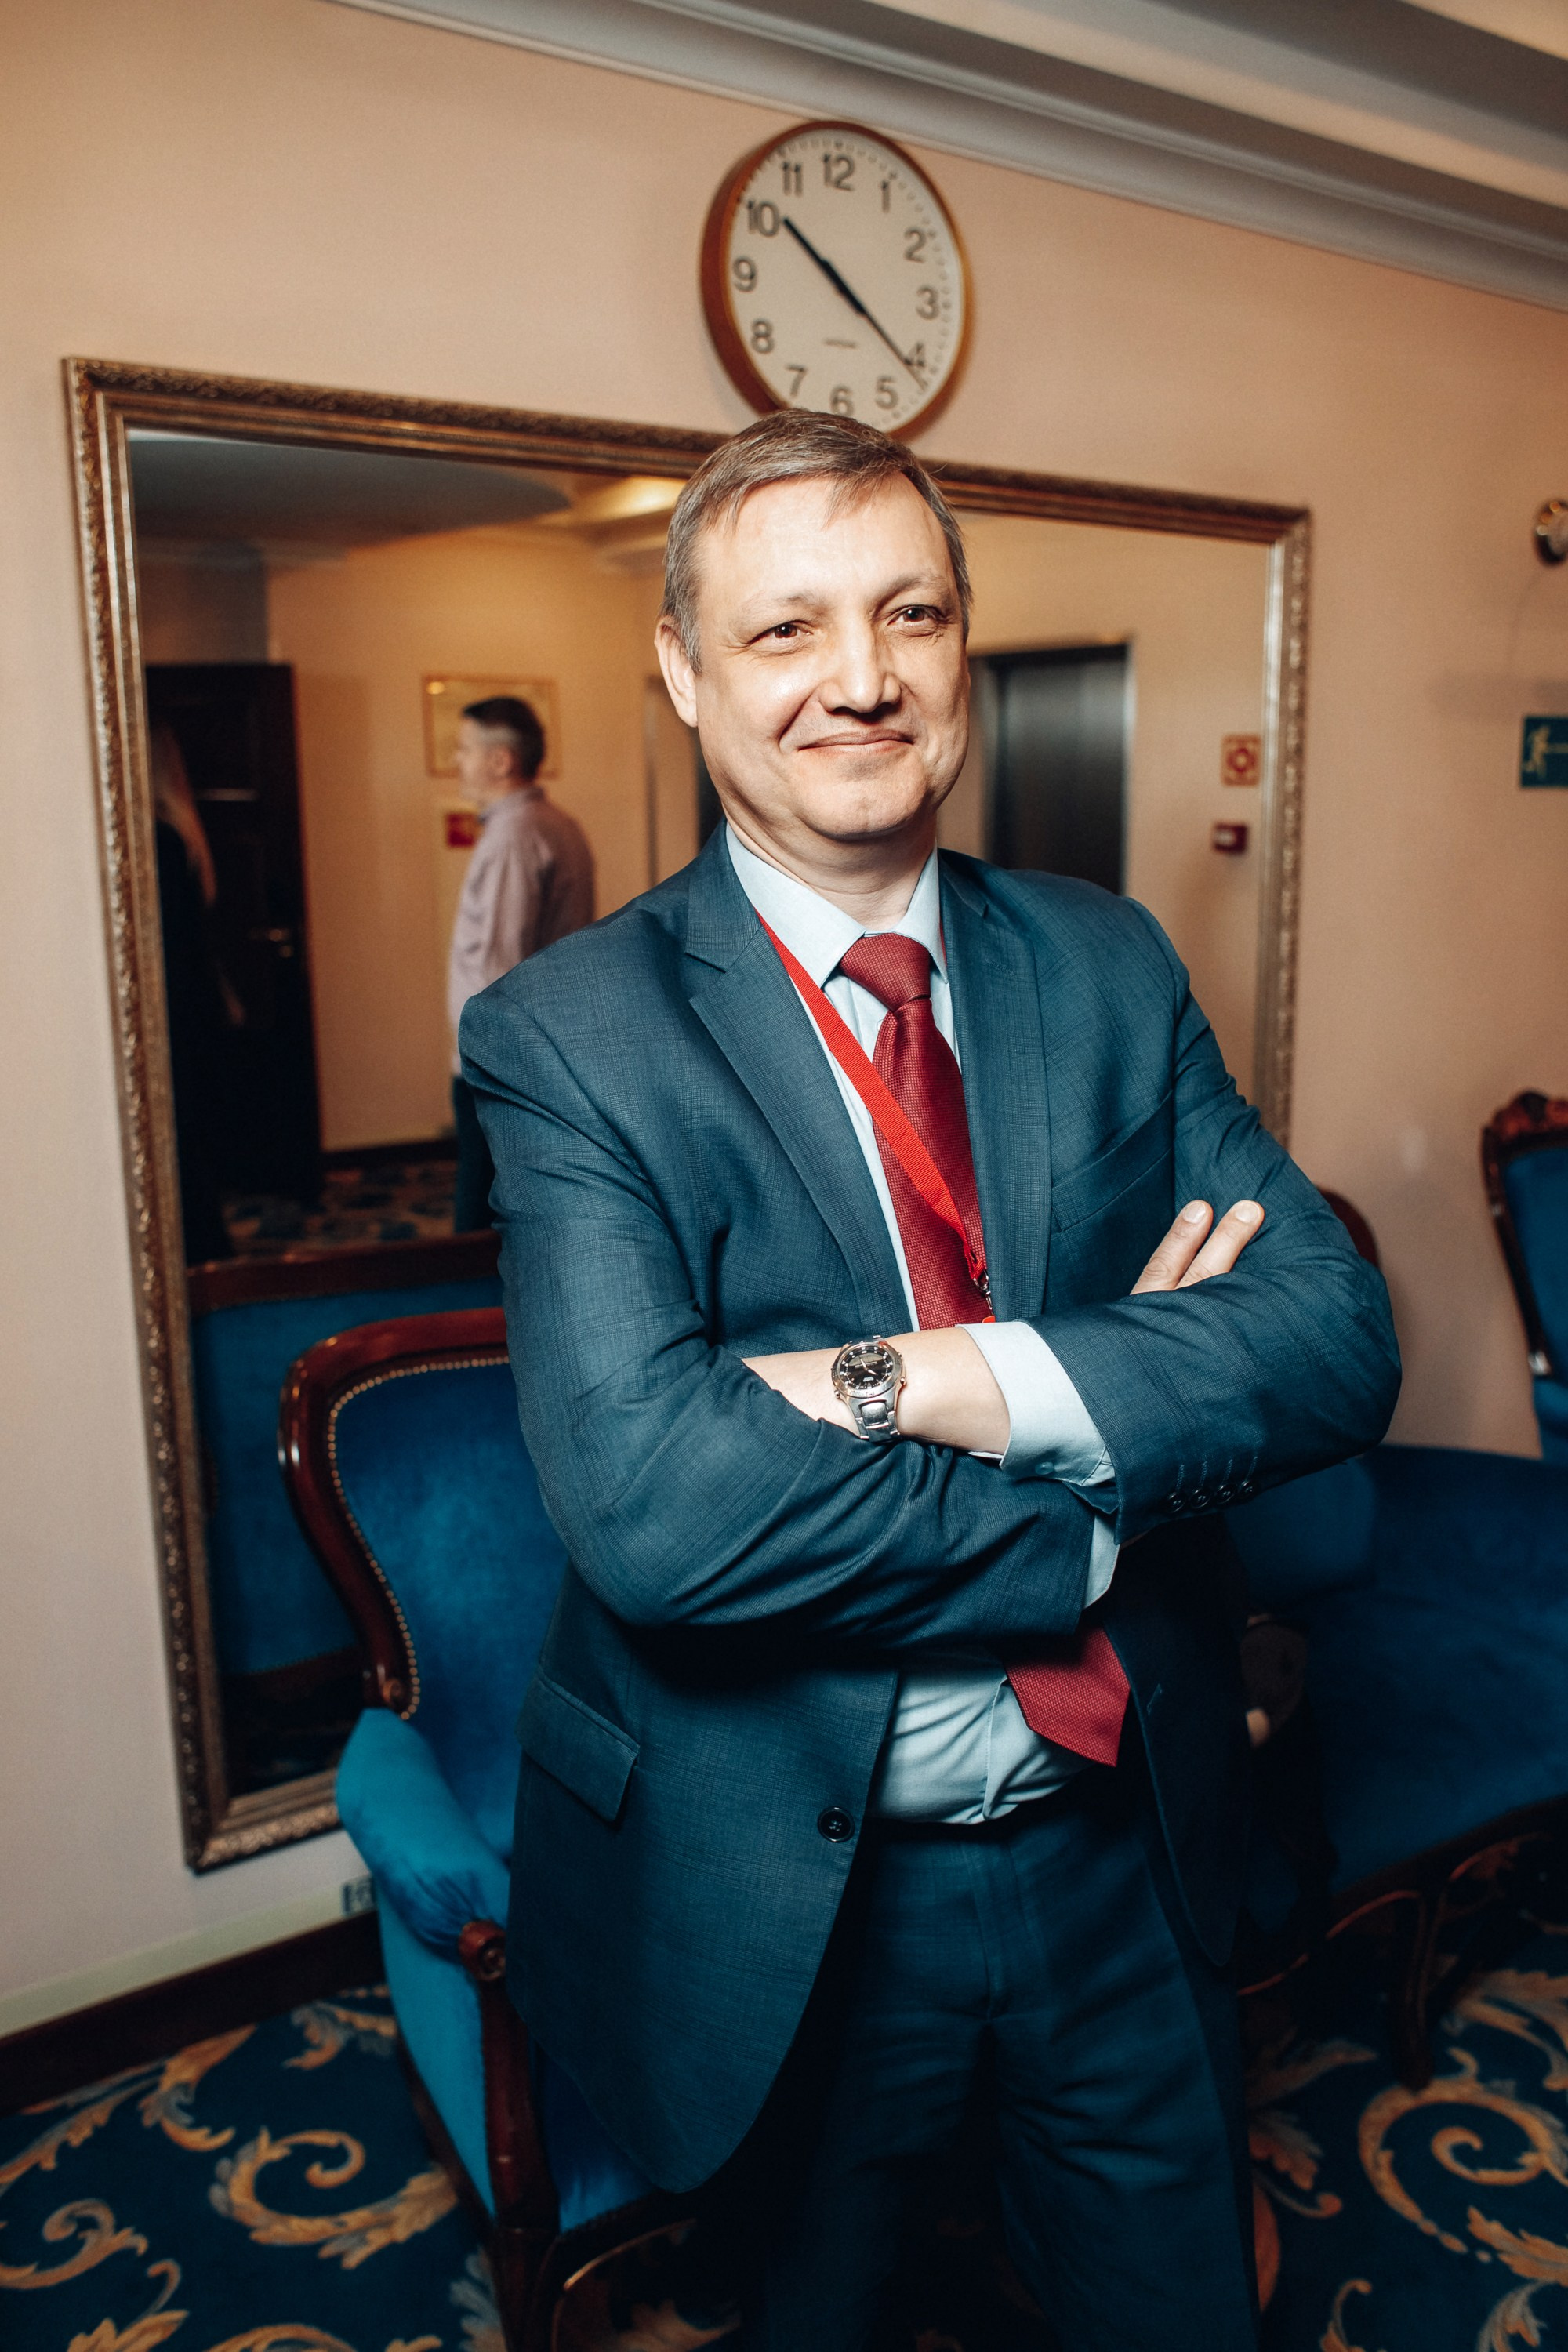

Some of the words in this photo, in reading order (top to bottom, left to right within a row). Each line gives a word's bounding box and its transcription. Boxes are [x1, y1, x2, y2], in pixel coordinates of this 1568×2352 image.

[782, 160, 803, 197] 11
[822, 154, 855, 191] 12
[880, 179, 891, 213] 1
[746, 199, 782, 238] 10
[904, 226, 927, 263] 2
[733, 255, 757, 292] 9
[916, 285, 941, 321] 3
[750, 318, 775, 354] 8
[903, 340, 927, 369] 4
[786, 363, 808, 397] 7
[874, 375, 899, 410] 5
[829, 384, 855, 417] 6
